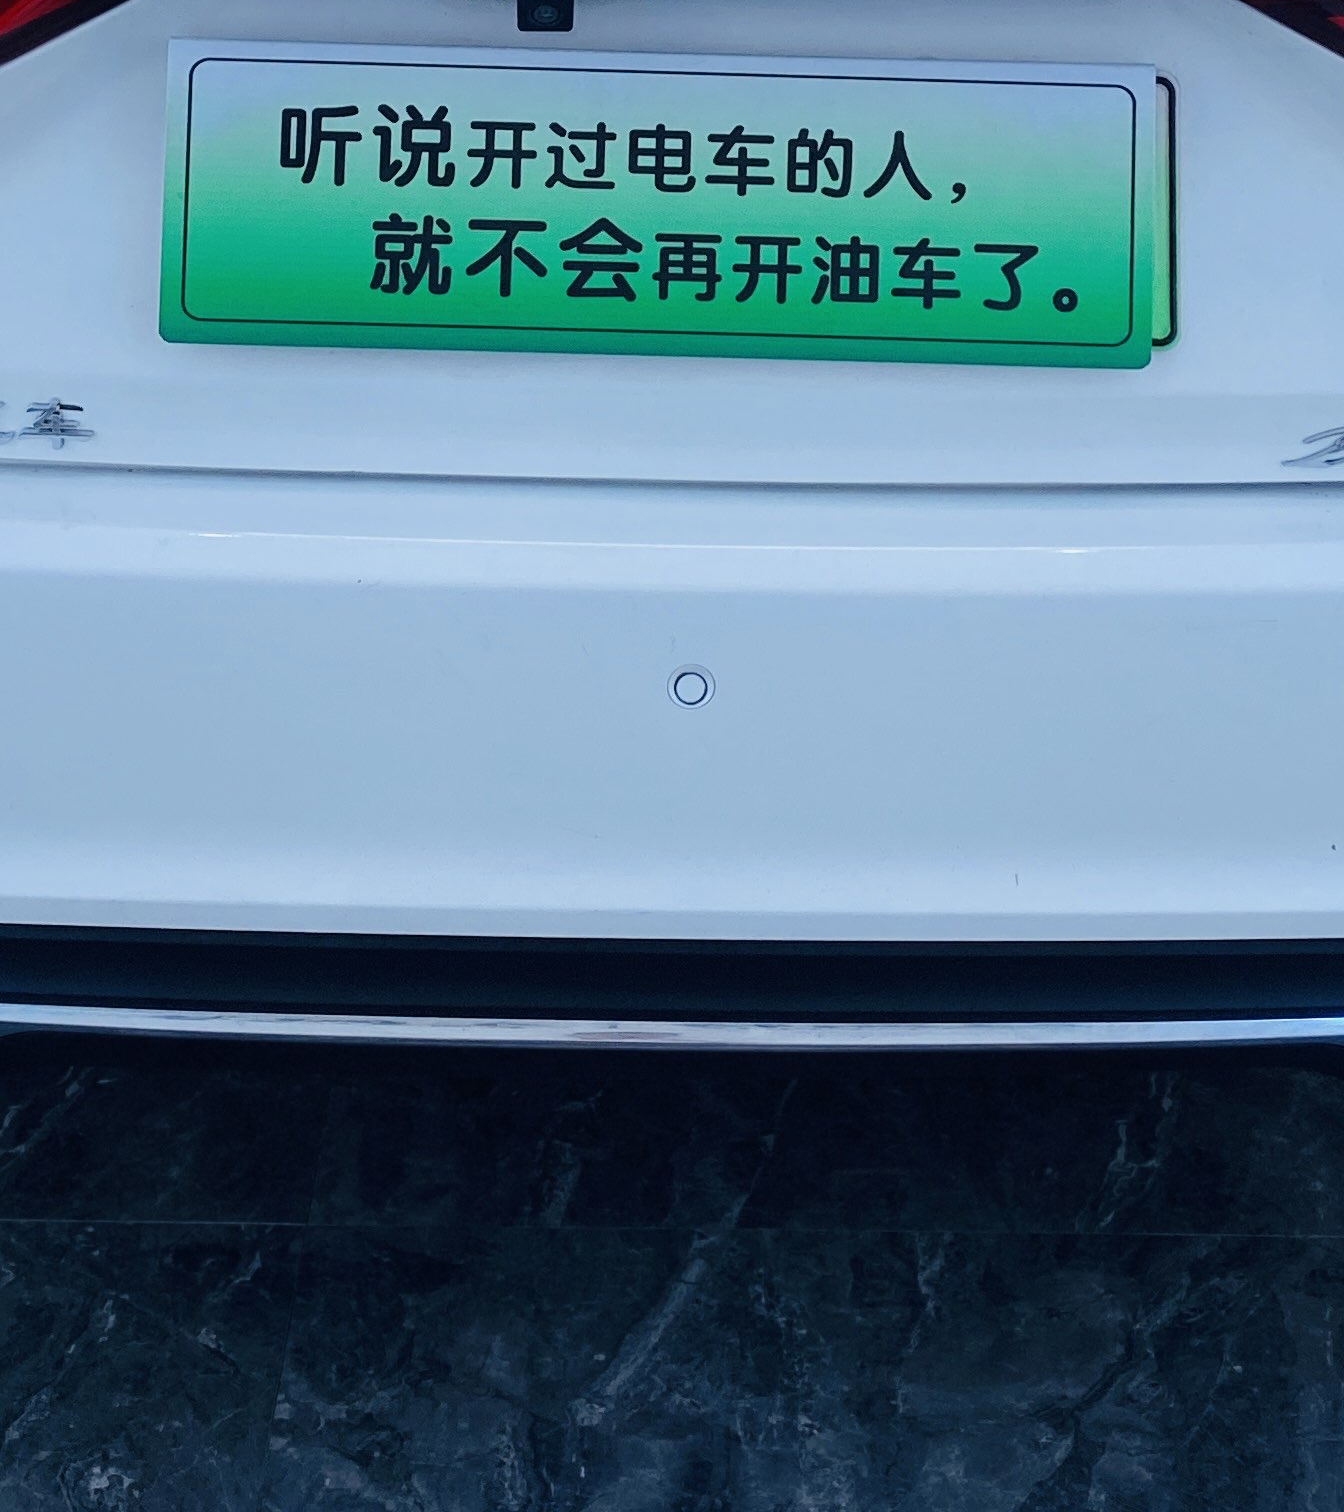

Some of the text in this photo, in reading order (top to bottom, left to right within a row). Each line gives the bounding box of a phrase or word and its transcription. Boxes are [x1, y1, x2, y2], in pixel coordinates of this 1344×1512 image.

[278, 103, 968, 205] 听说开过电车的人，
[368, 212, 1080, 314] 就不会再开油车了。
